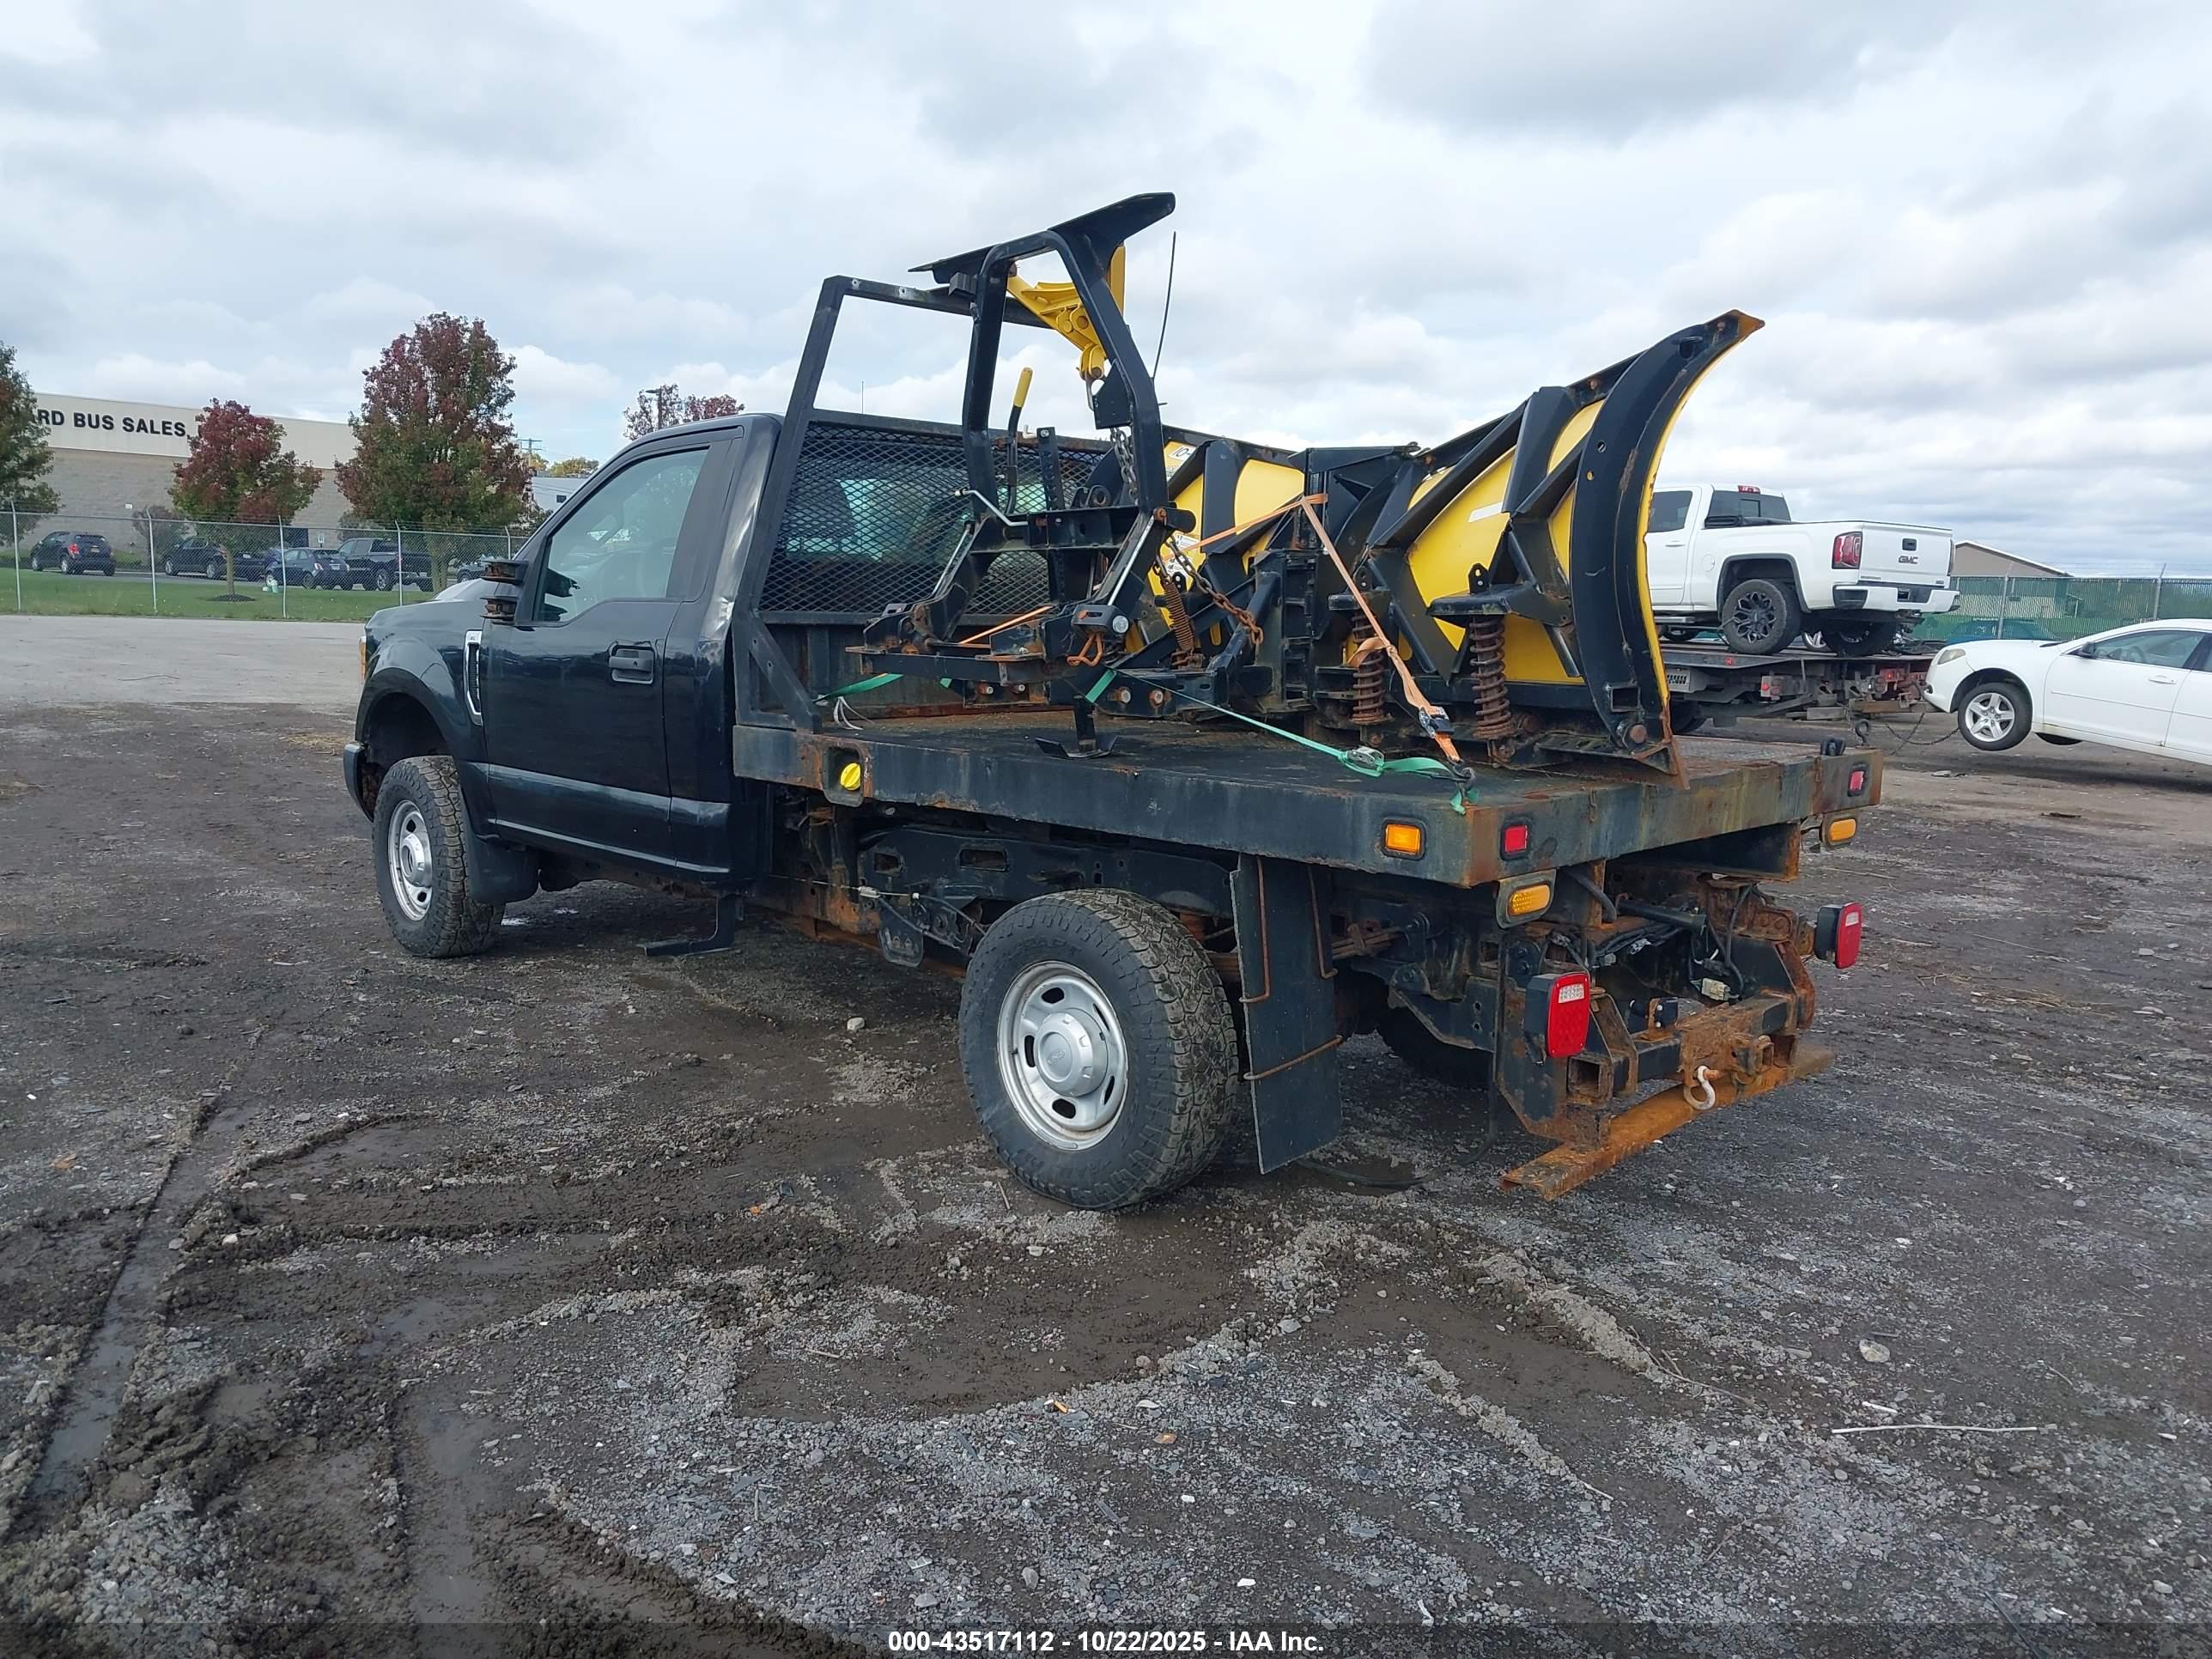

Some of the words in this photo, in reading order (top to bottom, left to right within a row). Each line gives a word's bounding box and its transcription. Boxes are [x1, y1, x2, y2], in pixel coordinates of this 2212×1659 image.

[37, 409, 65, 426] RD
[73, 412, 114, 430] BUS
[1898, 555, 1919, 565] GMC
